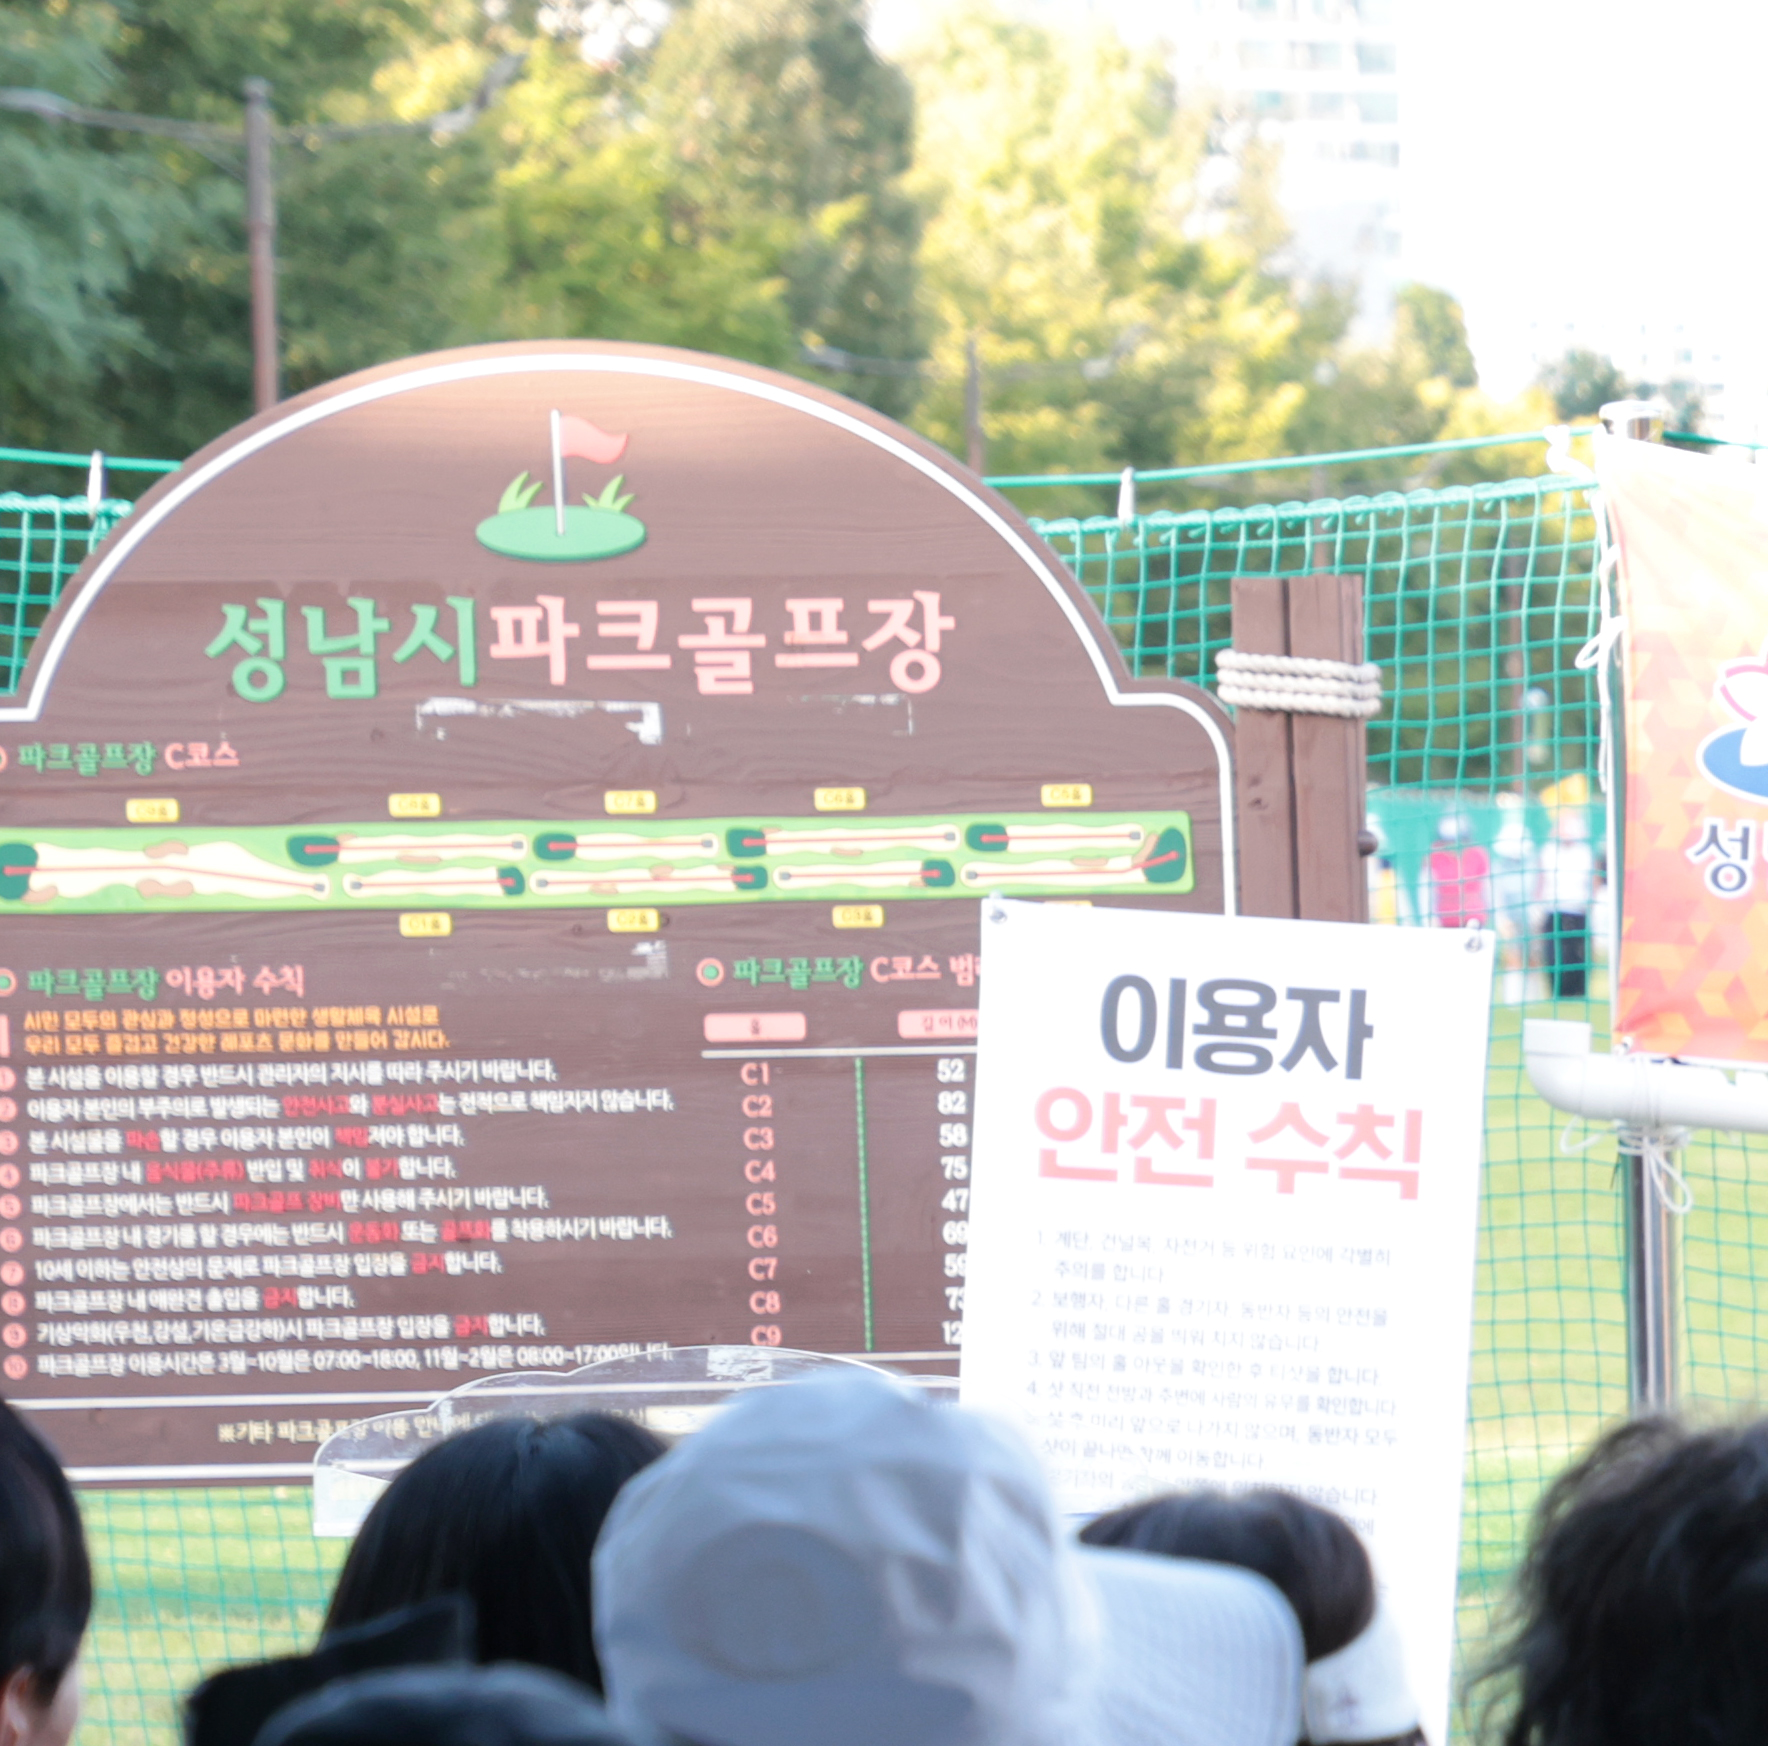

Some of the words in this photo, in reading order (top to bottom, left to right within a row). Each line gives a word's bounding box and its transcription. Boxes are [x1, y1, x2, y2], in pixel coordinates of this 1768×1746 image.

[18, 742, 157, 778] 파크골프장
[164, 741, 241, 769] C코스
[28, 966, 160, 1001] 파크골프장
[165, 965, 245, 1001] 이용자
[253, 964, 304, 998] 수칙
[733, 955, 864, 990] 파크골프장
[869, 955, 942, 983] C코스
[949, 953, 980, 986] 범
[24, 1010, 60, 1032] 시민
[64, 1009, 118, 1031] 모두의
[121, 1008, 176, 1030] 관심과
[179, 1007, 250, 1029] 정성으로
[253, 1007, 308, 1028] 마련한
[312, 1005, 382, 1027] 생활체육
[387, 1005, 440, 1027] 시설로
[1099, 973, 1375, 1081] 이용자
[24, 1034, 61, 1056] 우리
[65, 1033, 102, 1055] 모두
[105, 1032, 159, 1055] 즐겁고
[162, 1032, 217, 1054] 건강한
[278, 1030, 331, 1052] 문화를
[334, 1030, 389, 1051] 만들어
[26, 1065, 44, 1090] 본
[104, 1064, 160, 1090] 이용할
[162, 1063, 198, 1089] 경우
[200, 1063, 254, 1087] 반드시
[257, 1062, 329, 1087] 관리자의
[331, 1060, 384, 1086] 지시를
[386, 1061, 422, 1085] 따라
[425, 1059, 479, 1084] 주시기
[481, 1058, 559, 1084] 바랍니다.
[741, 1062, 770, 1085] C1
[937, 1058, 966, 1082] 52
[27, 1097, 82, 1123] 이용자
[84, 1097, 137, 1122] 본인의
[138, 1096, 209, 1121] 부주의로
[459, 1090, 529, 1115] 전적으로
[530, 1089, 598, 1114] 책임지지
[600, 1088, 676, 1113] 않습니다.
[742, 1094, 773, 1118] C2
[937, 1090, 967, 1115] 82
[28, 1129, 48, 1154] 본
[51, 1128, 123, 1154] 시설물을
[182, 1127, 218, 1152] 경우
[220, 1126, 274, 1151] 이용자
[278, 1125, 331, 1150] 본인이
[407, 1123, 466, 1147] 합니다.
[743, 1127, 774, 1151] C3
[938, 1122, 969, 1148] 58
[1034, 1086, 1218, 1188] 안전
[1245, 1101, 1424, 1201] 수칙
[29, 1161, 121, 1187] 파크골프장
[121, 1160, 144, 1184] 내
[246, 1157, 283, 1183] 반입
[285, 1157, 306, 1182] 및
[744, 1159, 776, 1183] C4
[940, 1155, 969, 1181] 75
[30, 1191, 174, 1219] 파크골프장에서는
[175, 1190, 231, 1216] 반드시
[361, 1187, 417, 1213] 사용해
[419, 1186, 471, 1211] 주시기
[473, 1185, 550, 1210] 바랍니다.
[745, 1192, 777, 1216] C5
[941, 1187, 970, 1212] 47
[31, 1224, 122, 1251] 파크골프장
[122, 1224, 144, 1249] 내
[144, 1223, 197, 1249] 경기를
[198, 1222, 218, 1248] 할
[220, 1222, 291, 1247] 경우에는
[291, 1220, 347, 1246] 반드시
[400, 1219, 439, 1244] 또는
[510, 1216, 598, 1241] 착용하시기
[598, 1214, 674, 1241] 바랍니다.
[747, 1224, 778, 1249] C6
[943, 1220, 968, 1245] 69
[34, 1258, 75, 1283] 10세
[75, 1257, 131, 1282] 이하는
[132, 1256, 204, 1281] 안전상의
[206, 1254, 262, 1279] 문제로
[262, 1252, 352, 1278] 파크골프장
[354, 1251, 408, 1277] 입장을
[410, 1250, 504, 1275] 금지합니다.
[748, 1257, 778, 1281] C7
[34, 1288, 126, 1314] 파크골프장
[127, 1287, 148, 1313] 내
[205, 1285, 260, 1311] 출입을
[262, 1285, 357, 1309] 금지합니다.
[750, 1290, 781, 1314] C8
[306, 1315, 395, 1342] 파크골프장
[397, 1314, 450, 1339] 입장을
[454, 1313, 547, 1338] 금지합니다.
[751, 1324, 782, 1348] C9
[37, 1352, 127, 1378] 파크골프장
[128, 1351, 216, 1377] 이용시간은
